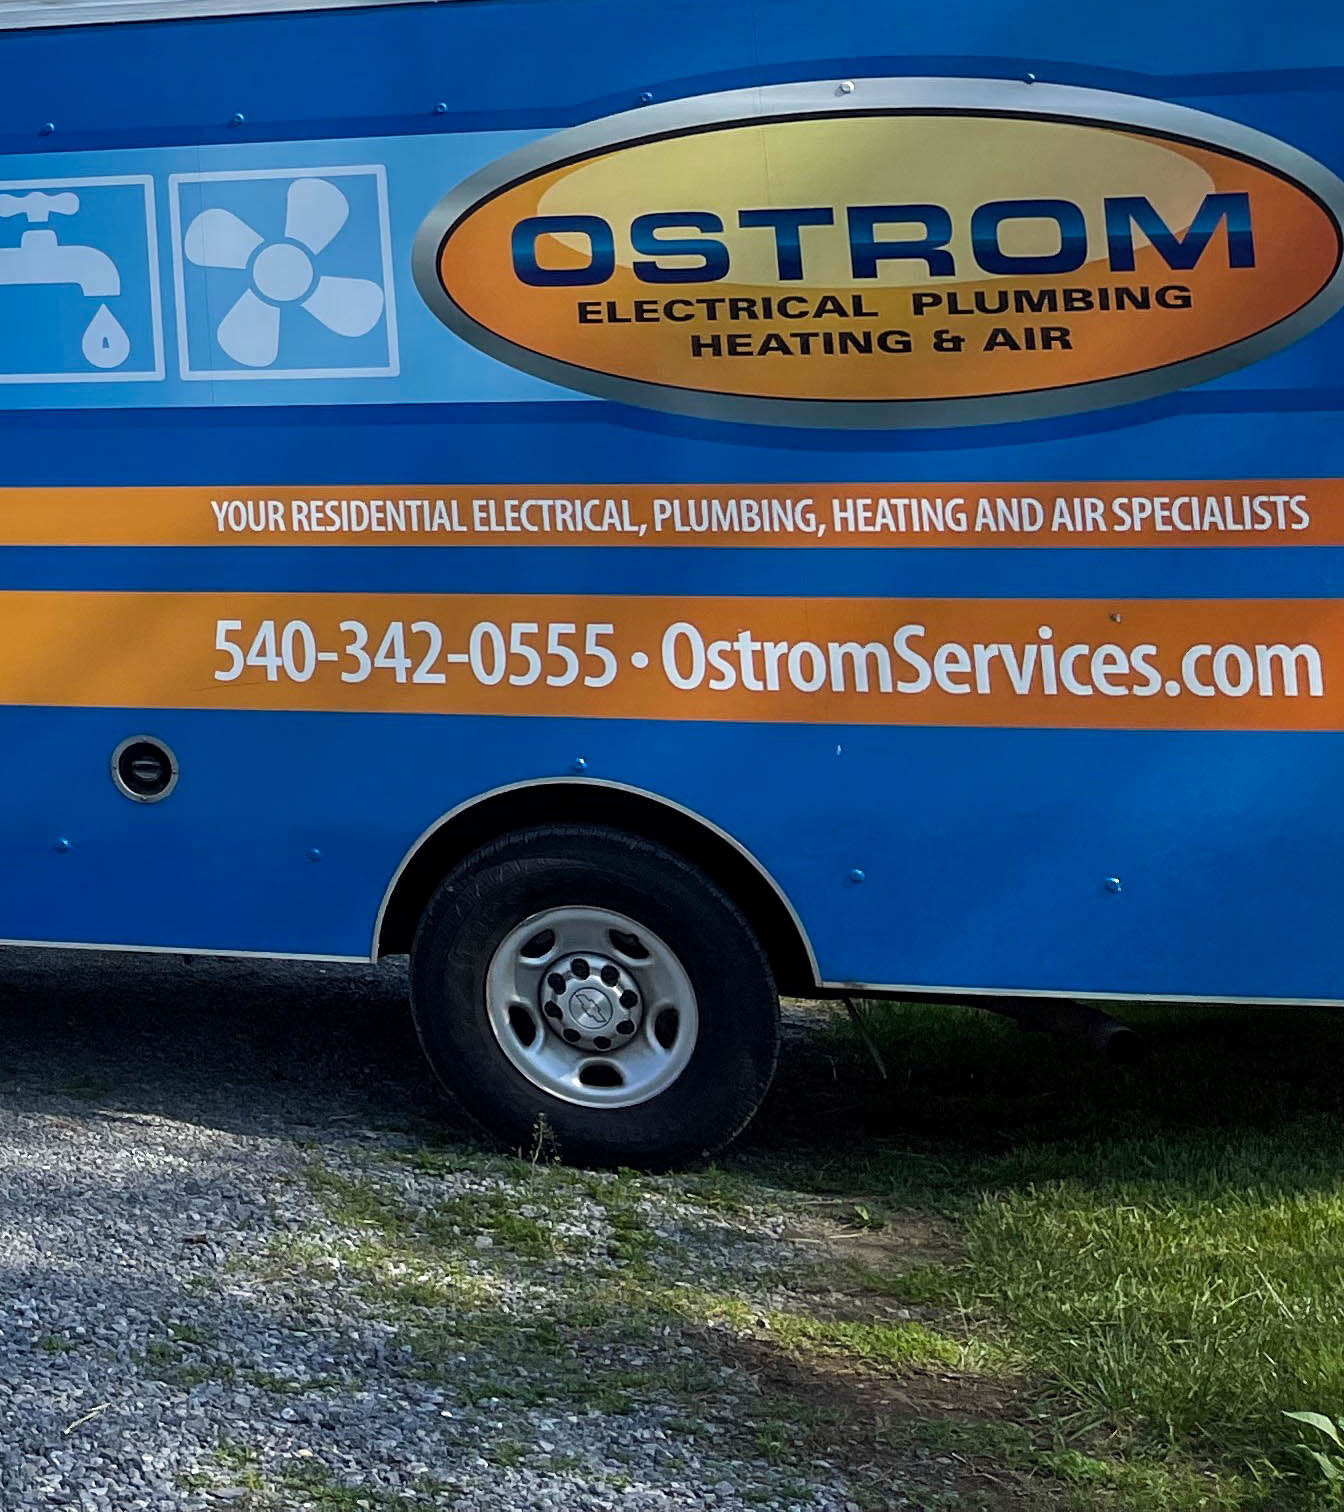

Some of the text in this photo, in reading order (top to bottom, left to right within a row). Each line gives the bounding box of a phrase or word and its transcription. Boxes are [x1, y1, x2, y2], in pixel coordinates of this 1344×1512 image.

[511, 192, 1256, 287] OSTROM
[577, 286, 1193, 325] ELECTRICAL PLUMBING
[690, 326, 1073, 358] HEATING & AIR
[211, 495, 1310, 537] YOUR RESIDENTIAL ELECTRICAL, PLUMBING, HEATING AND AIR SPECIALISTS
[213, 619, 1324, 696] 540-342-0555 OstromServices.com
